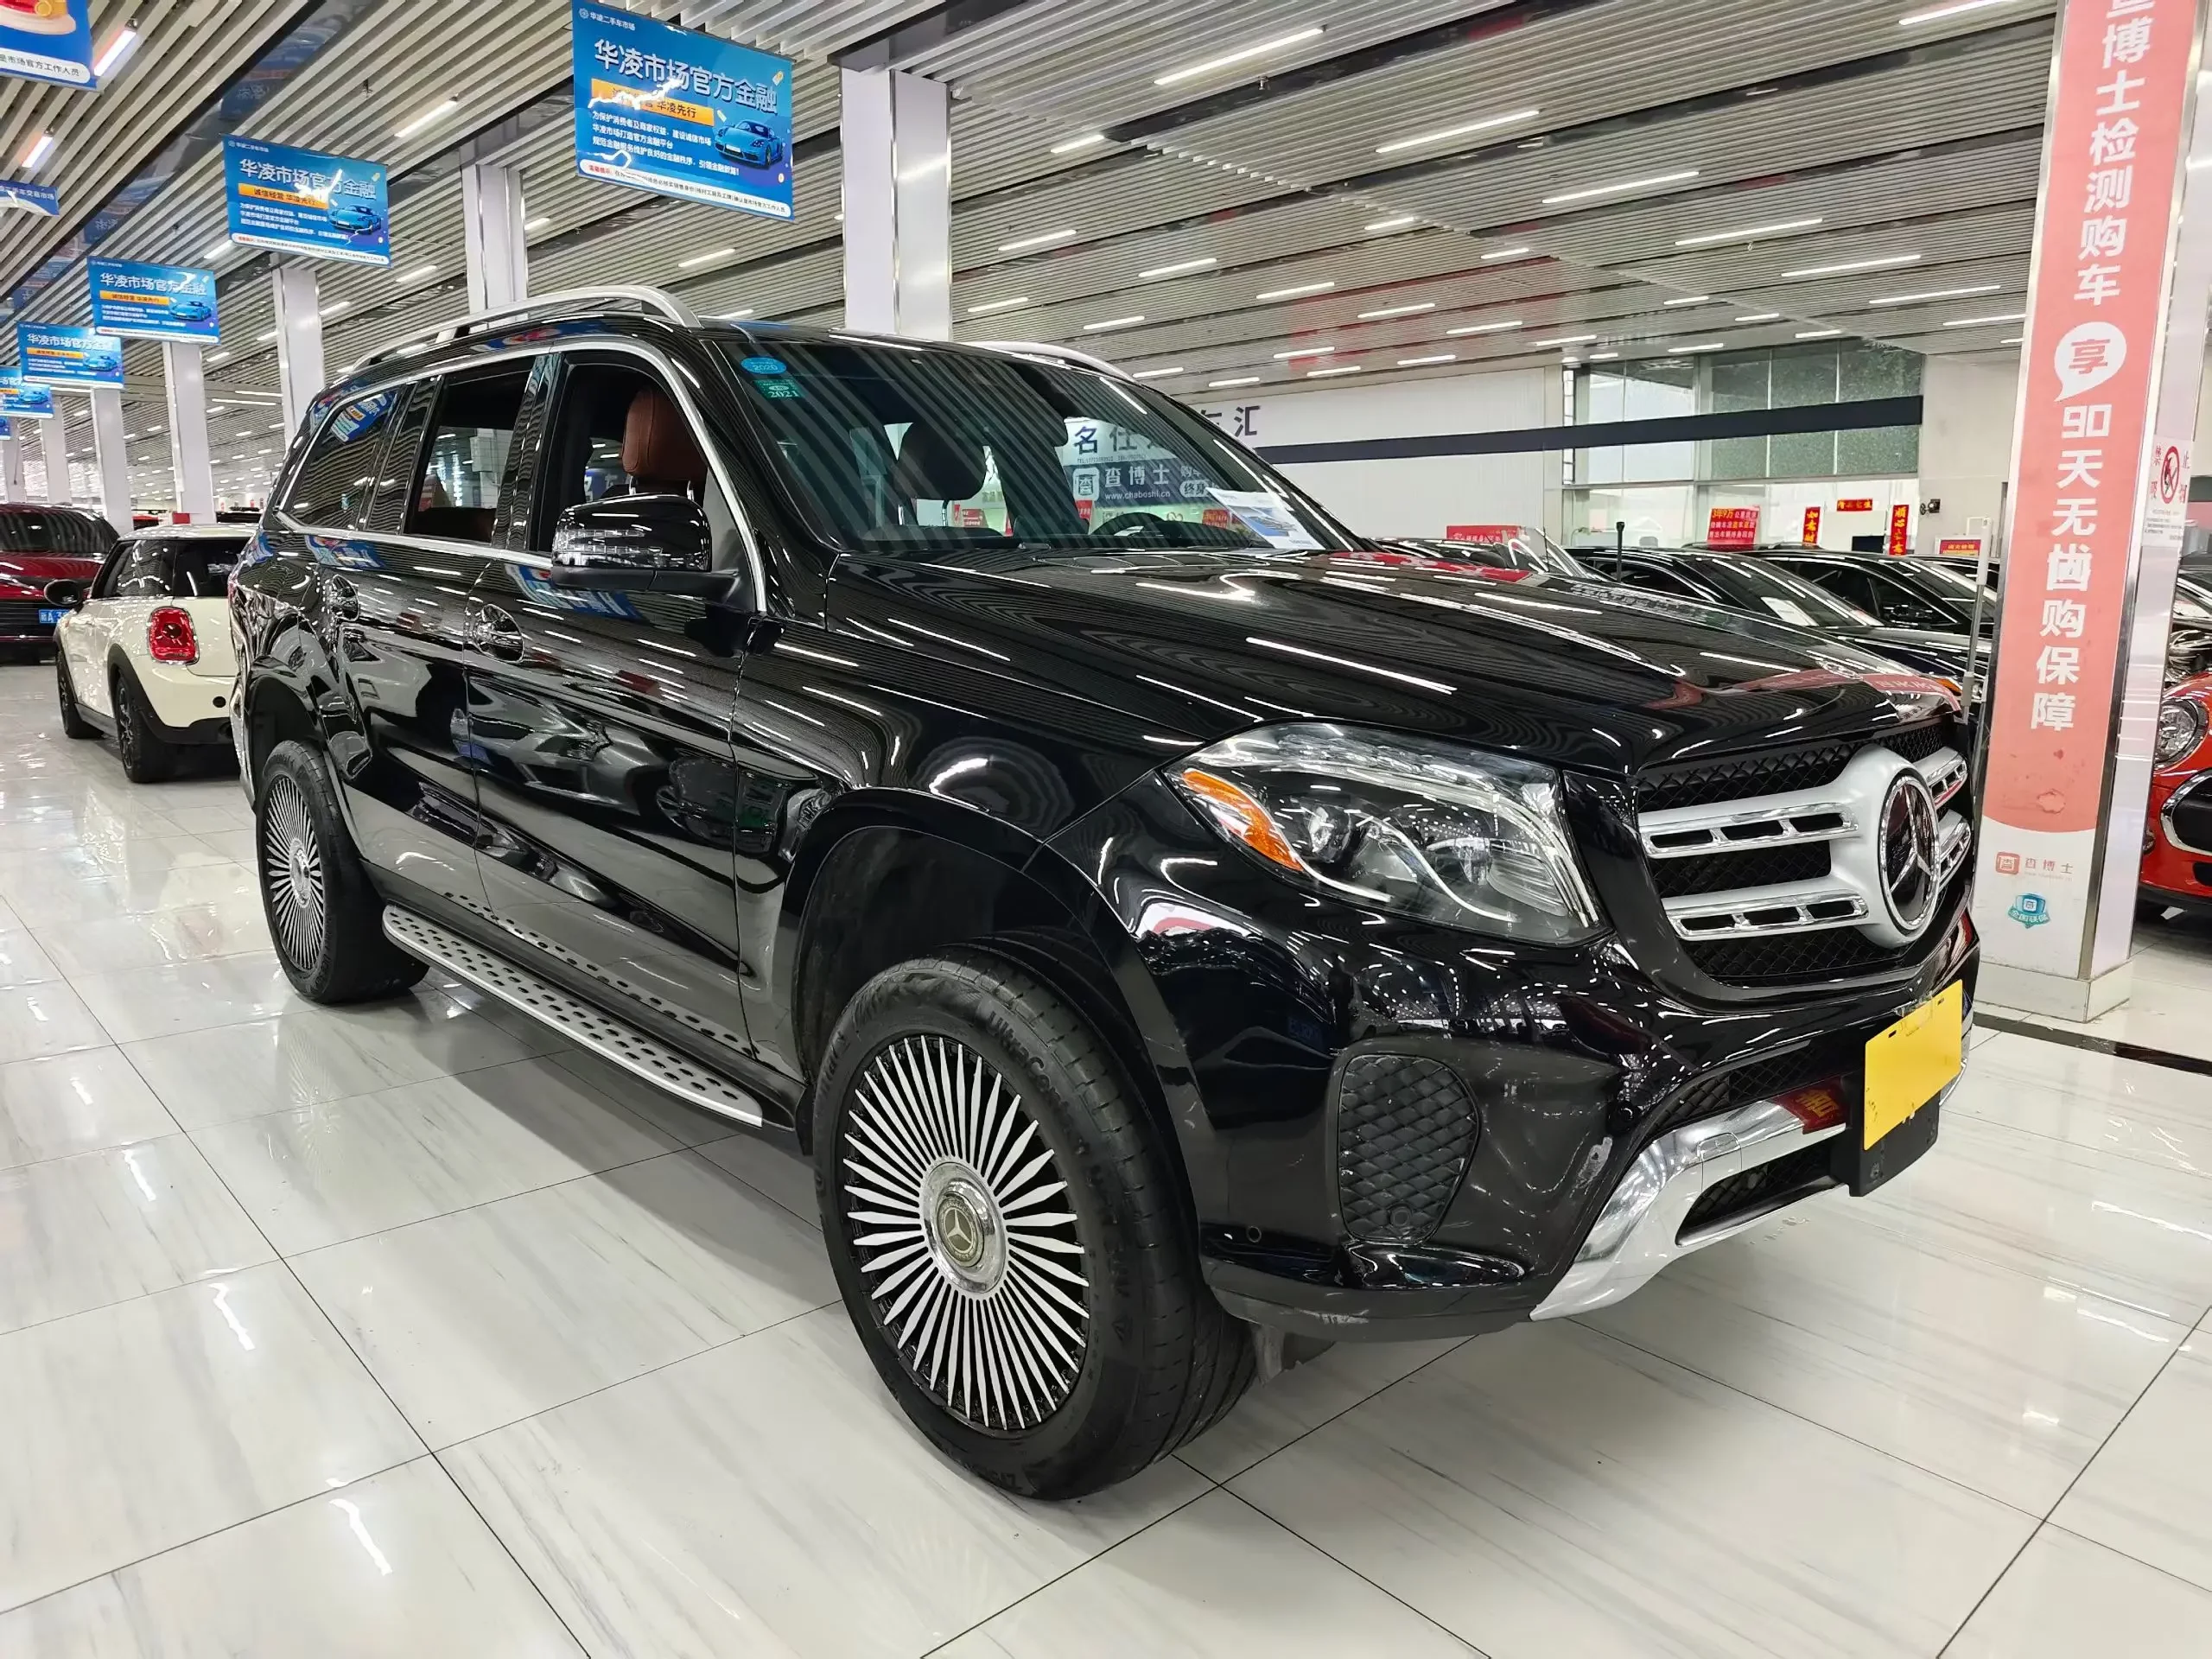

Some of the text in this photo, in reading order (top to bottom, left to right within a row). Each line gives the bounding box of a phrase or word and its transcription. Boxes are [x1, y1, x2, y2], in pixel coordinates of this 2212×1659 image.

[594, 39, 778, 114] 华凌市场官方金融
[657, 100, 697, 118] 华凌先行
[239, 158, 377, 200] 华凌市场官方金融
[27, 334, 113, 351] 华凌市场官方金
[2068, 339, 2110, 375] 享
[1105, 463, 1169, 487] 查博士
[1105, 490, 1170, 500] www.chaboshi.cn
[2024, 857, 2074, 874] 查博士
